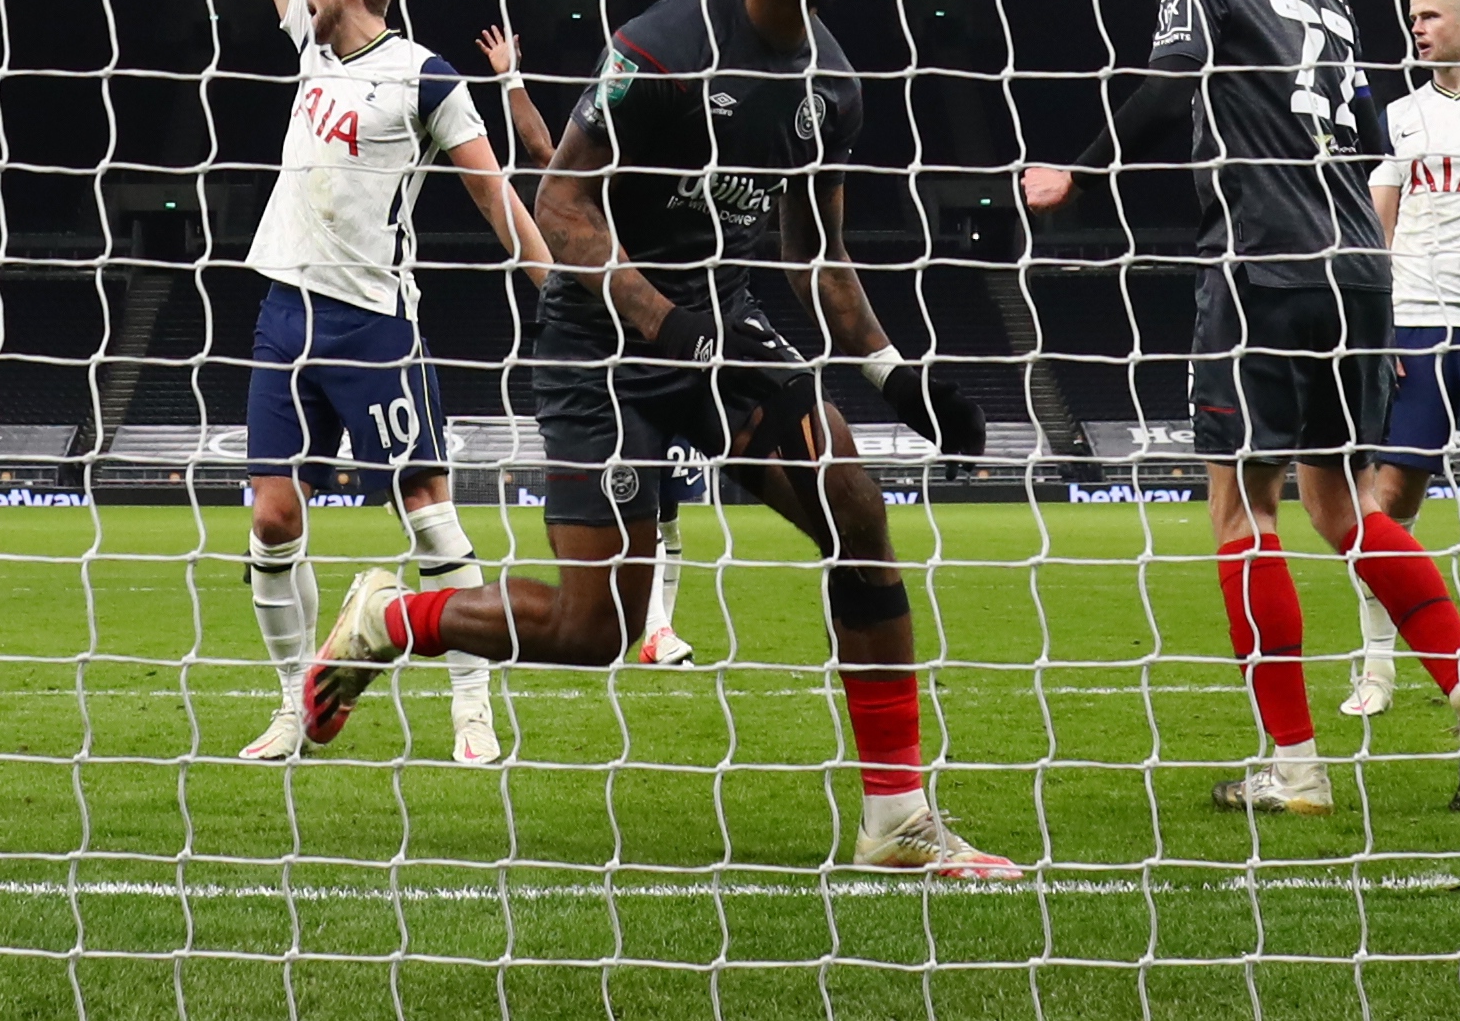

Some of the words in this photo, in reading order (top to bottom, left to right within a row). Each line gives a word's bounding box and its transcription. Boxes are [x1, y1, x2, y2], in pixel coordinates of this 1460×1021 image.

[293, 87, 359, 157] AIA
[369, 402, 420, 450] 10
[1069, 484, 1191, 503] betway
